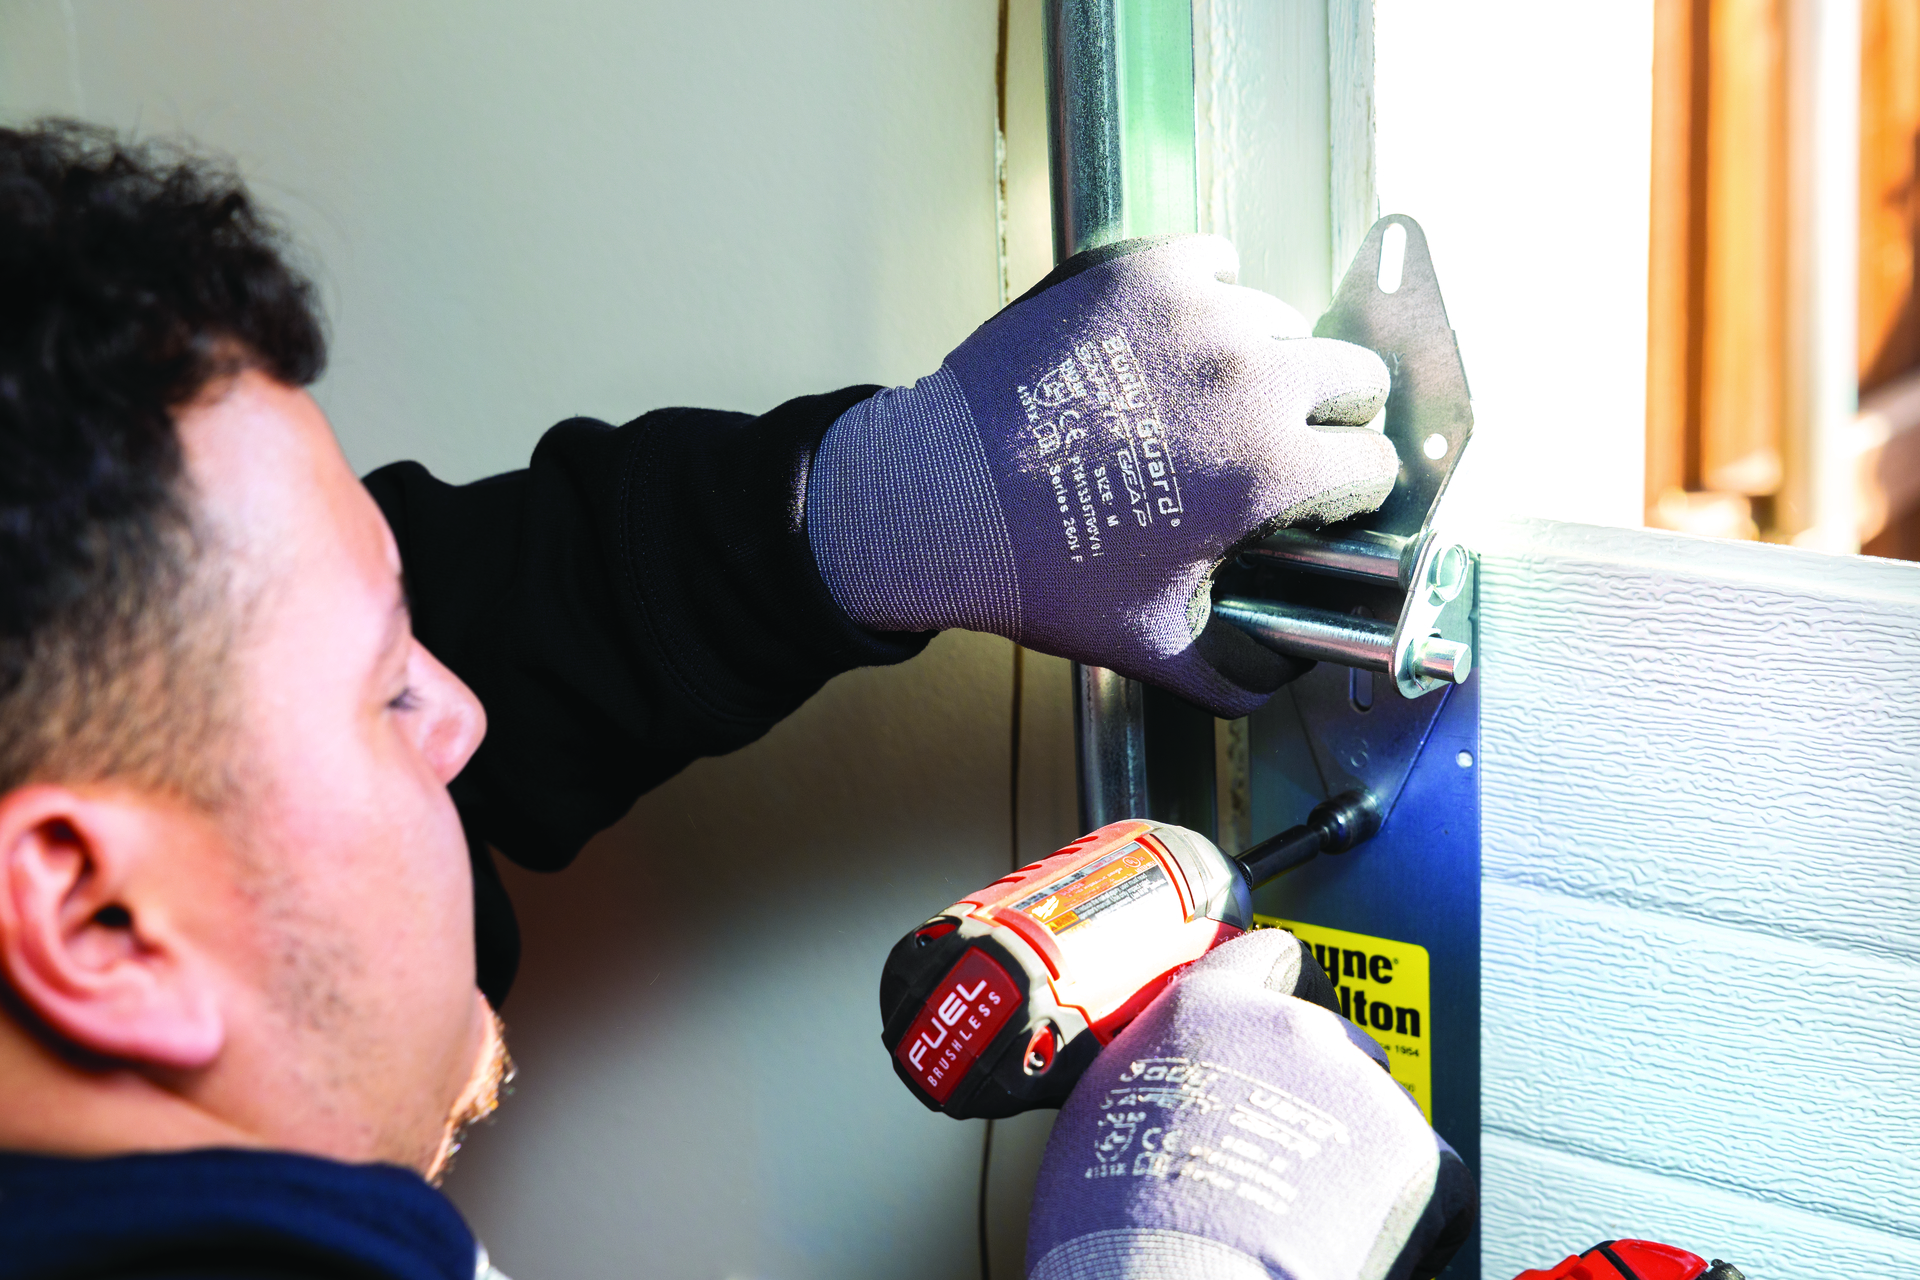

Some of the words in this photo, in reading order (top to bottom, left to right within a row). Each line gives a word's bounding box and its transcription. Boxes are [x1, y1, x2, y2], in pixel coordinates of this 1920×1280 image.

[1049, 464, 1069, 513] Series
[1106, 514, 1119, 527] M
[909, 980, 987, 1072] FUEL
[927, 991, 1001, 1087] BRUSHLESS
